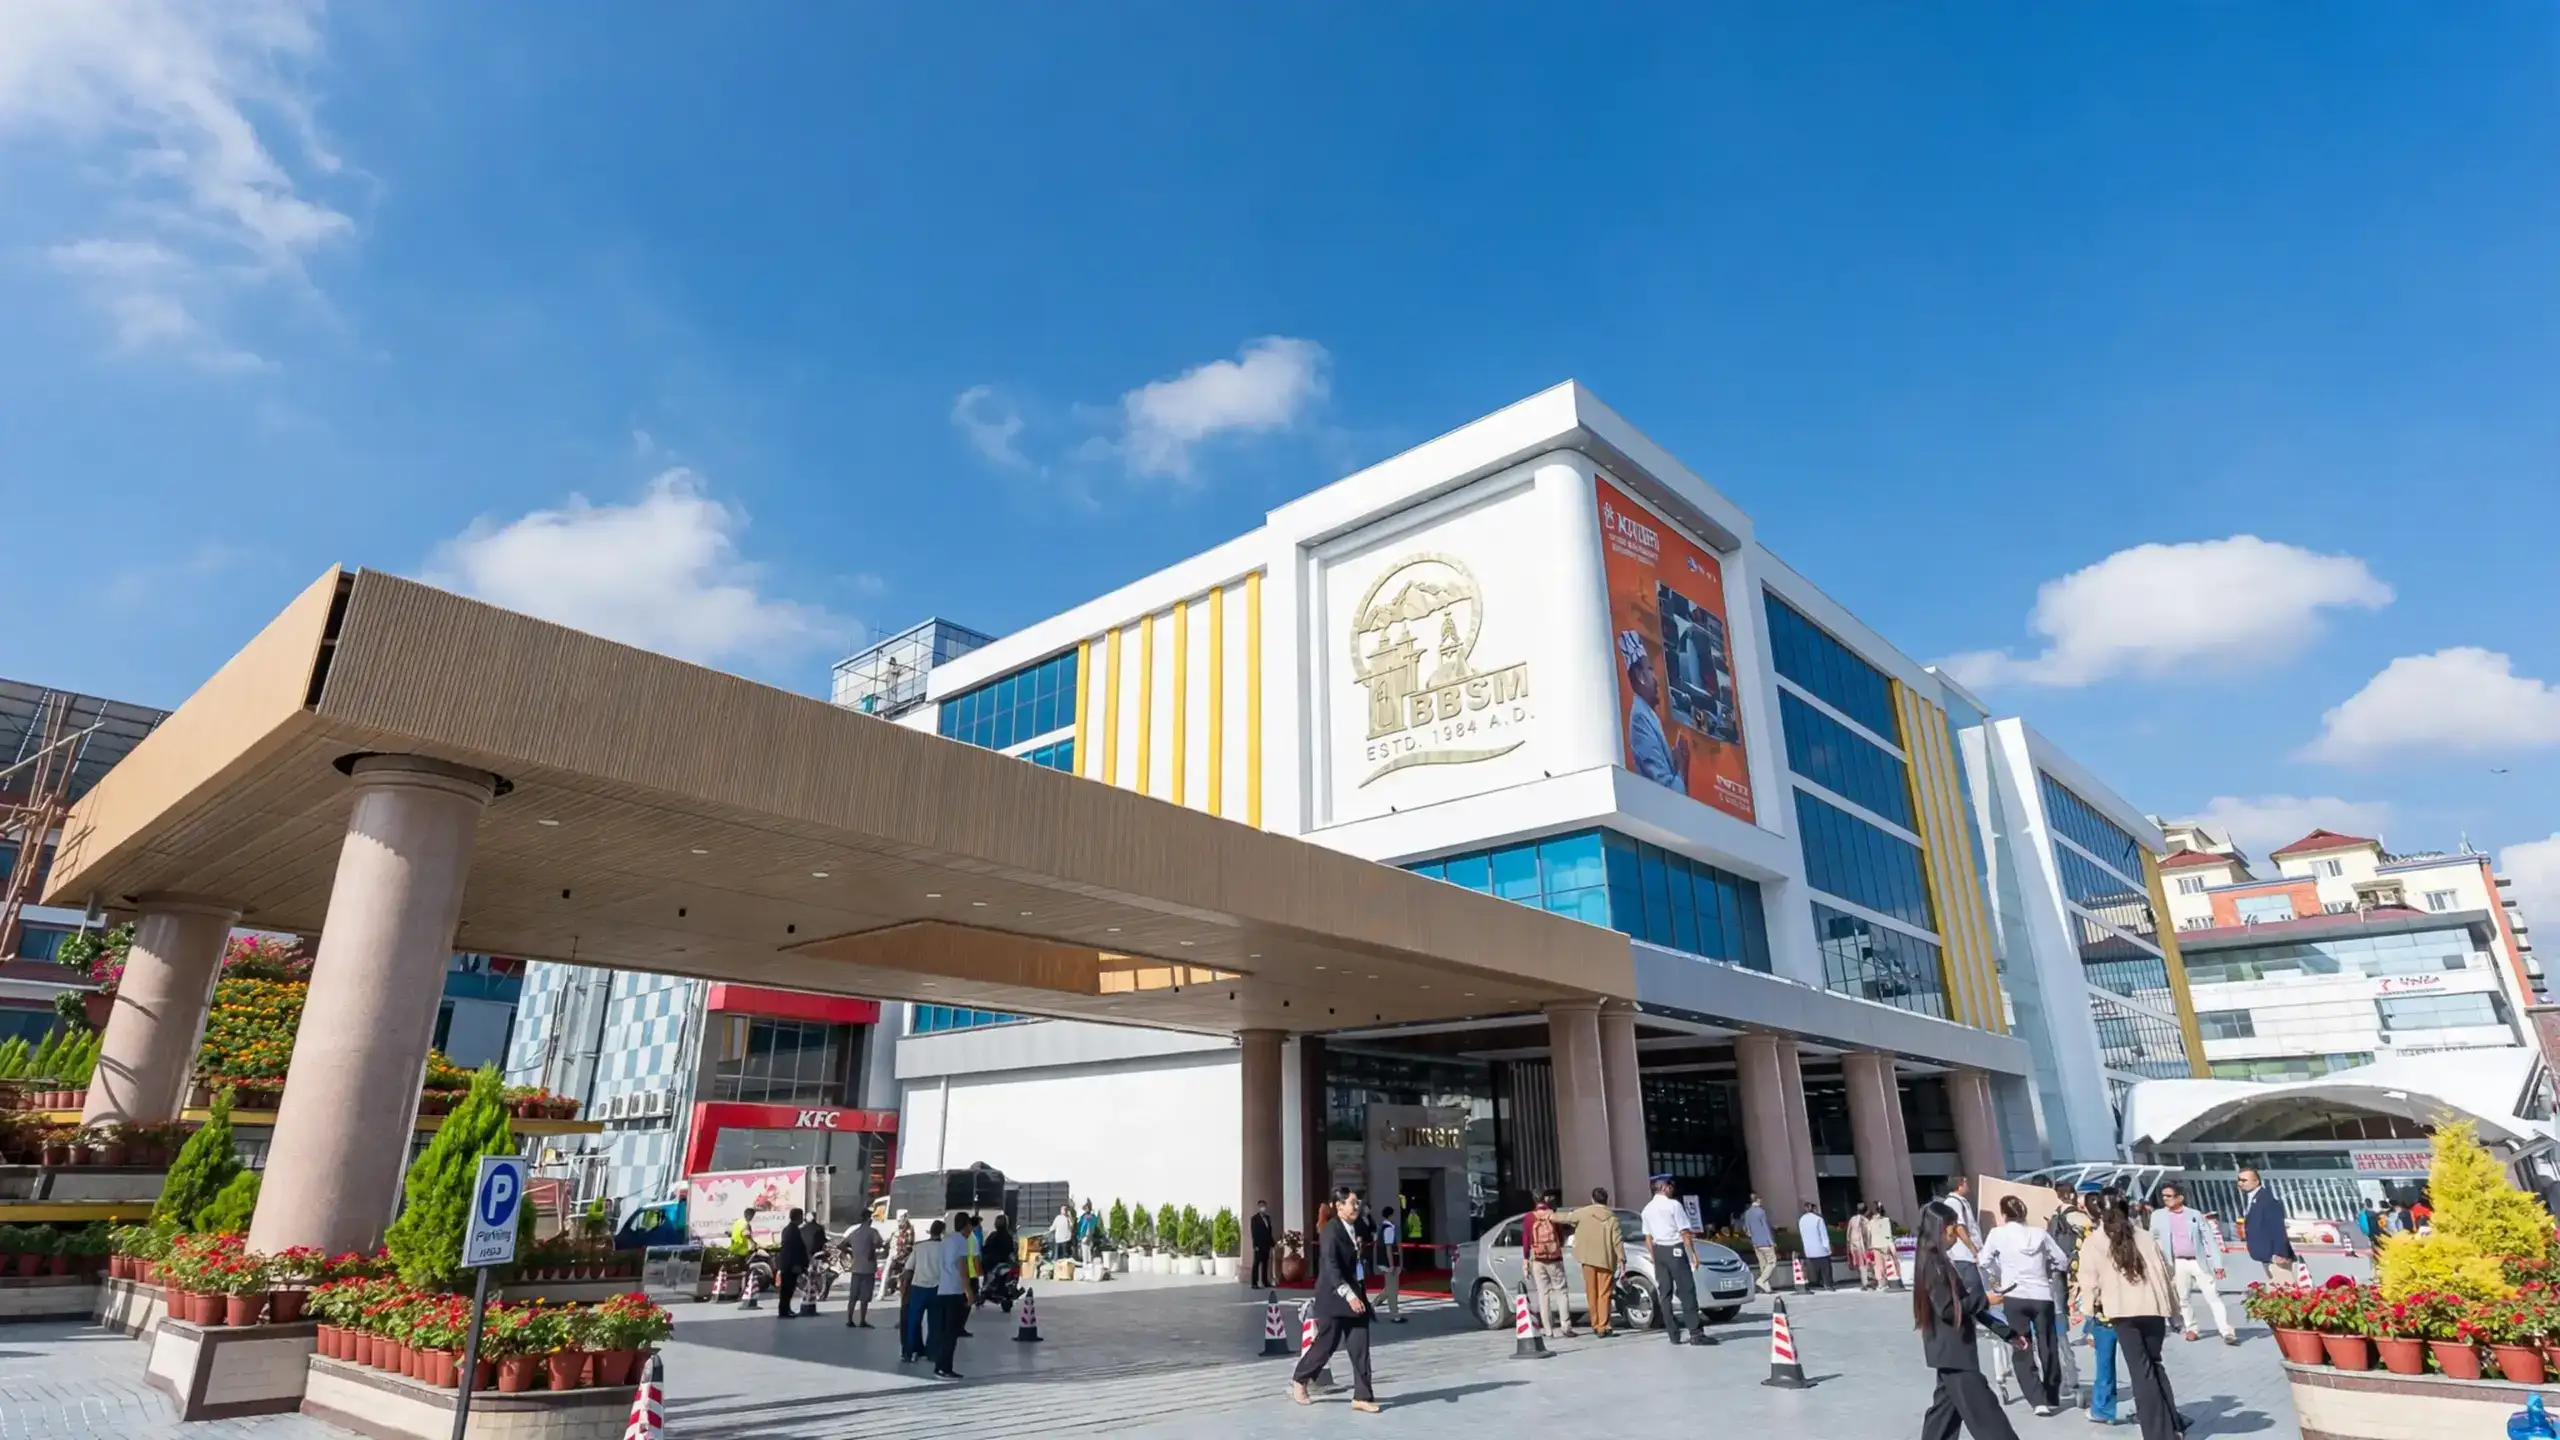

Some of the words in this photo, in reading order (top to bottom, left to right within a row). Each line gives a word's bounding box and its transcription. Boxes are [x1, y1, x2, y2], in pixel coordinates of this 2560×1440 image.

[1410, 665, 1529, 728] BBSM
[1366, 736, 1423, 762] ESTD.
[1433, 719, 1478, 744] 1984
[1489, 707, 1536, 729] A.D.
[795, 1109, 841, 1129] KFC
[487, 1174, 513, 1220] P
